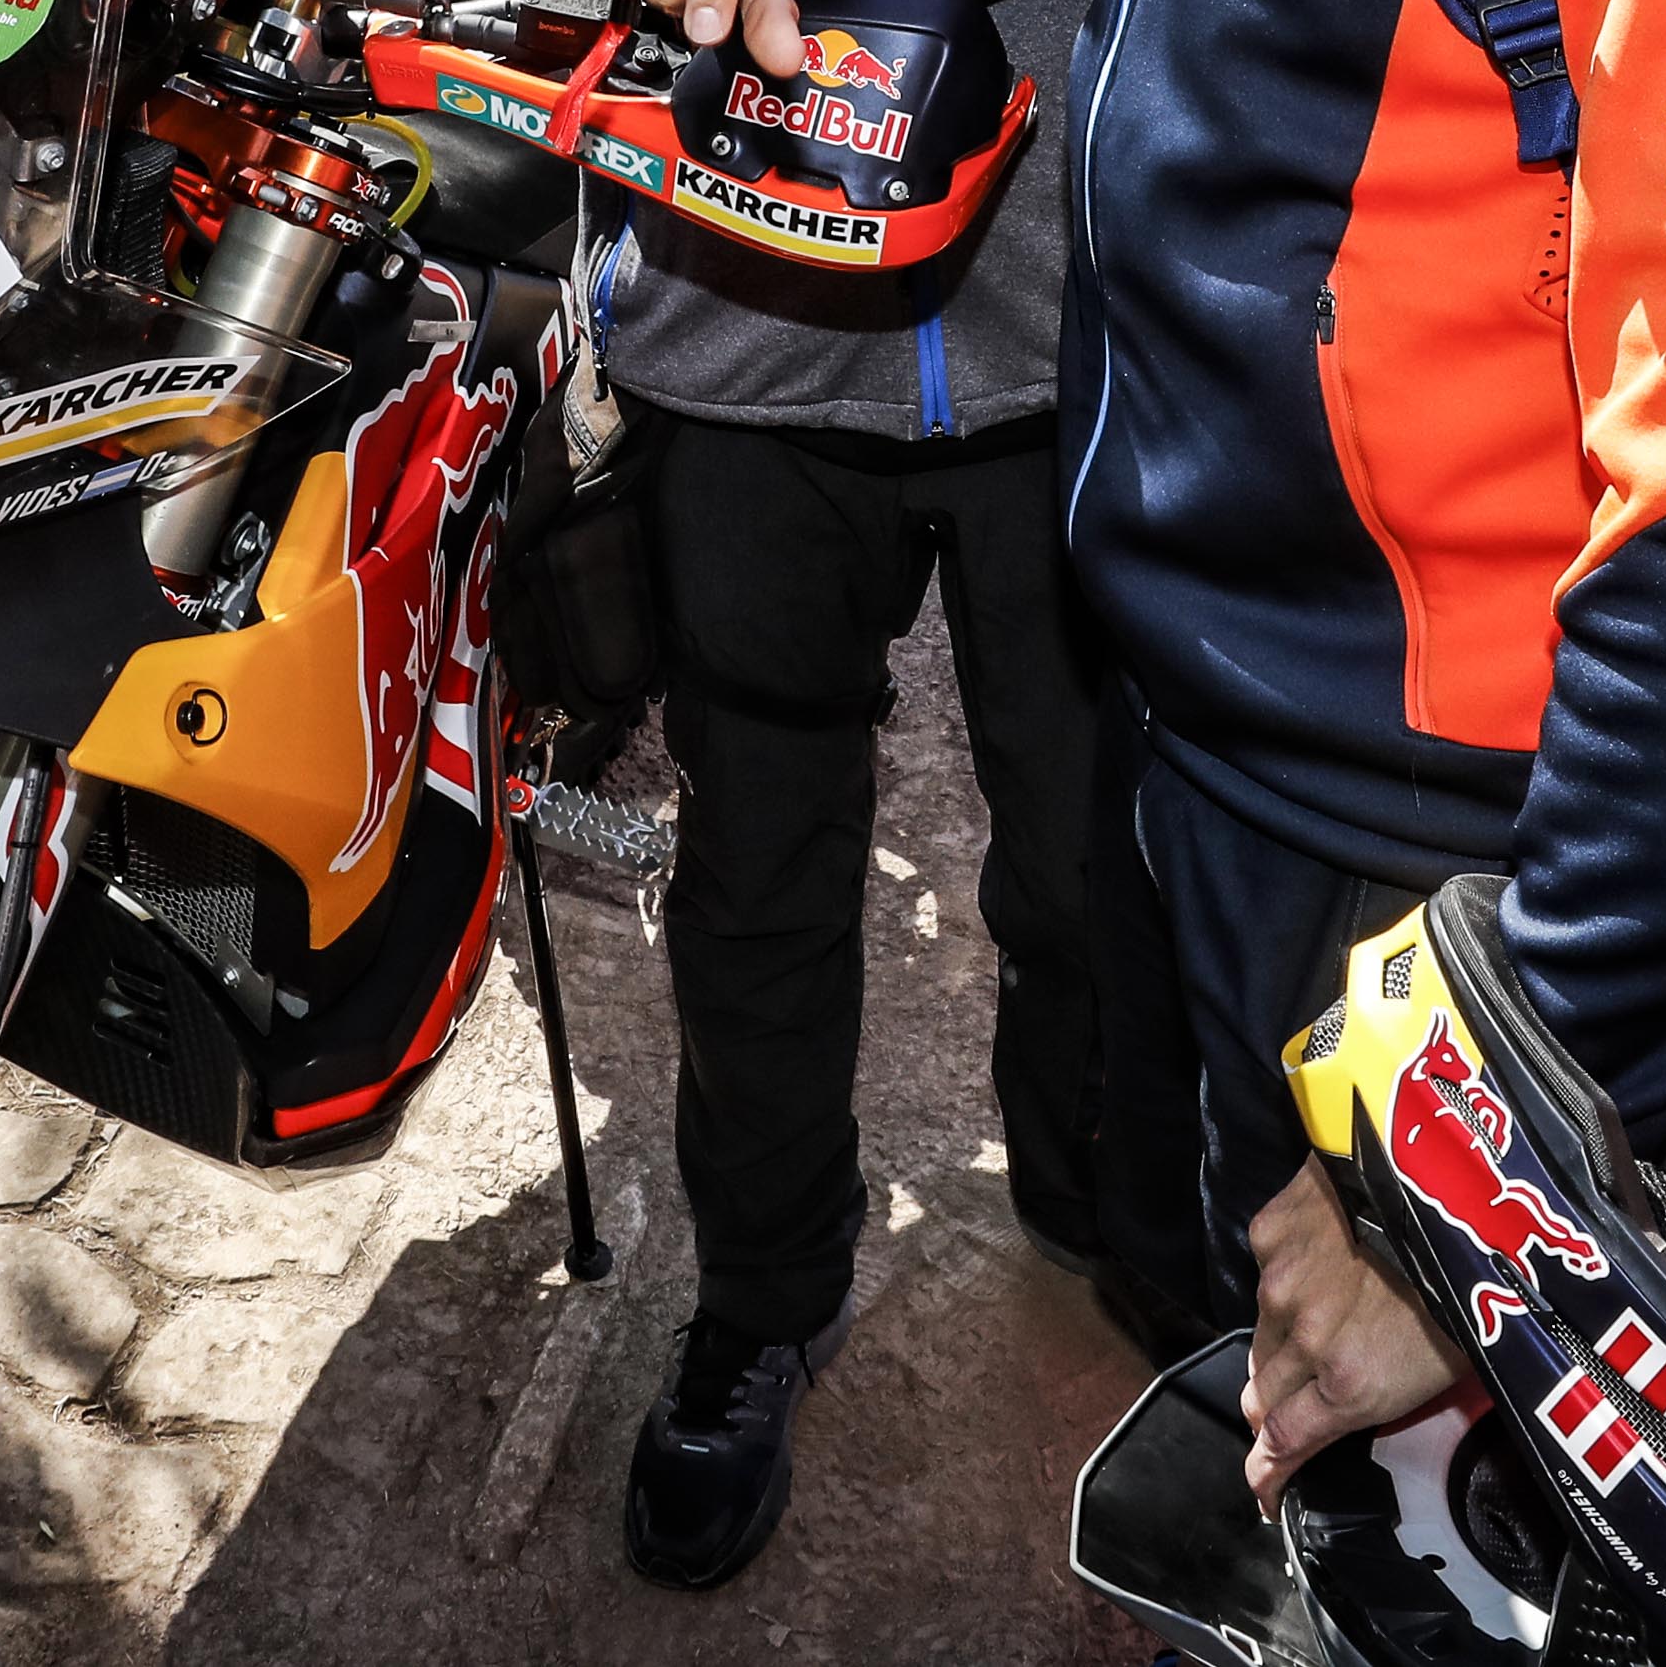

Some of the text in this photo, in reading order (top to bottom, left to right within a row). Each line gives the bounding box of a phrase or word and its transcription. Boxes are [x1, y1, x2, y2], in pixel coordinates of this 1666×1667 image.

[538, 21, 575, 35] brembo
[724, 71, 913, 162] Red Bull
[676, 161, 880, 246] KÄRCHER
[1557, 1468, 1643, 1574] WUNSCHEL.de
[1644, 1569, 1656, 1586] by
